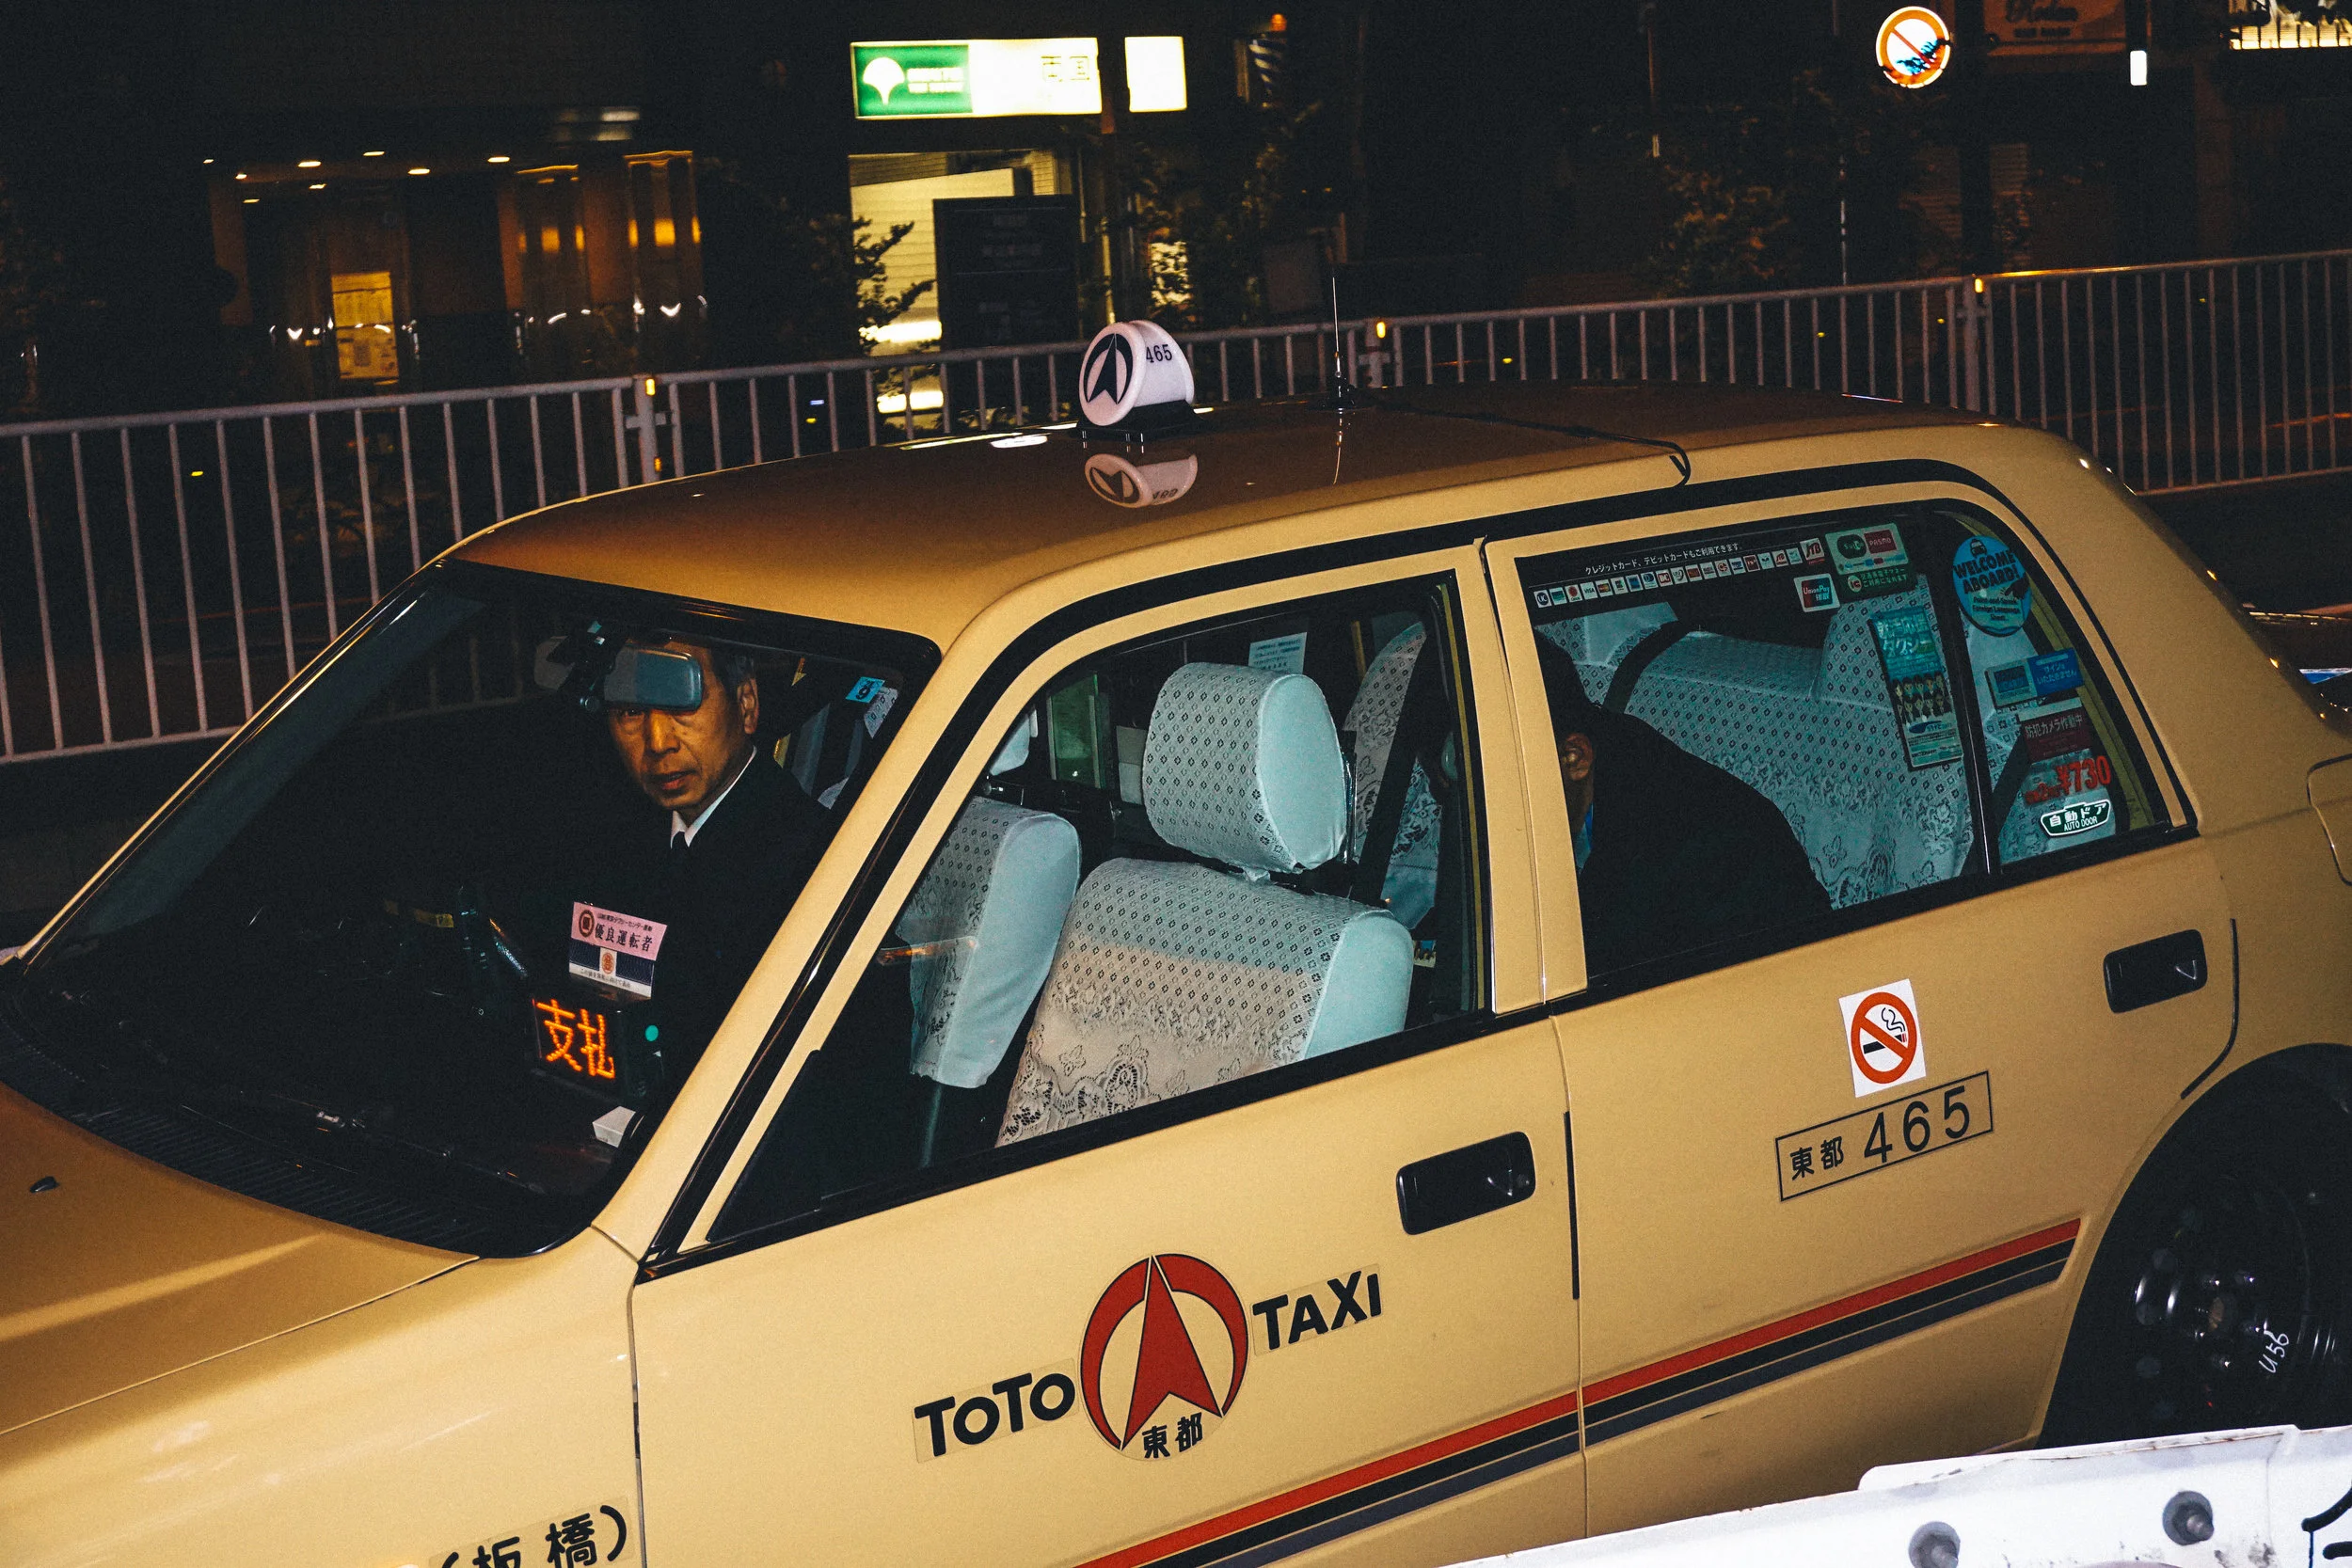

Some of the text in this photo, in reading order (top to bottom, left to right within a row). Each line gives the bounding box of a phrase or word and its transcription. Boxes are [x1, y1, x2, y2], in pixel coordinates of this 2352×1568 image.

[1145, 343, 1173, 363] 465
[1869, 537, 1892, 546] PASMO
[1953, 549, 2016, 578] WELCOME
[1803, 584, 1830, 595] UnionPay
[1963, 564, 2020, 594] ABOARD!
[2025, 714, 2084, 739] 防犯カメラ作動中
[2057, 755, 2111, 795] ¥730
[2049, 802, 2106, 827] 自動ドア
[2063, 816, 2098, 832] AUTO DOOR
[595, 923, 653, 952] 優良運転者
[535, 999, 616, 1080] 支払
[1790, 1085, 1970, 1180] 東都 465
[1251, 1270, 1382, 1351] TAXI
[1141, 1411, 1204, 1459] 東都
